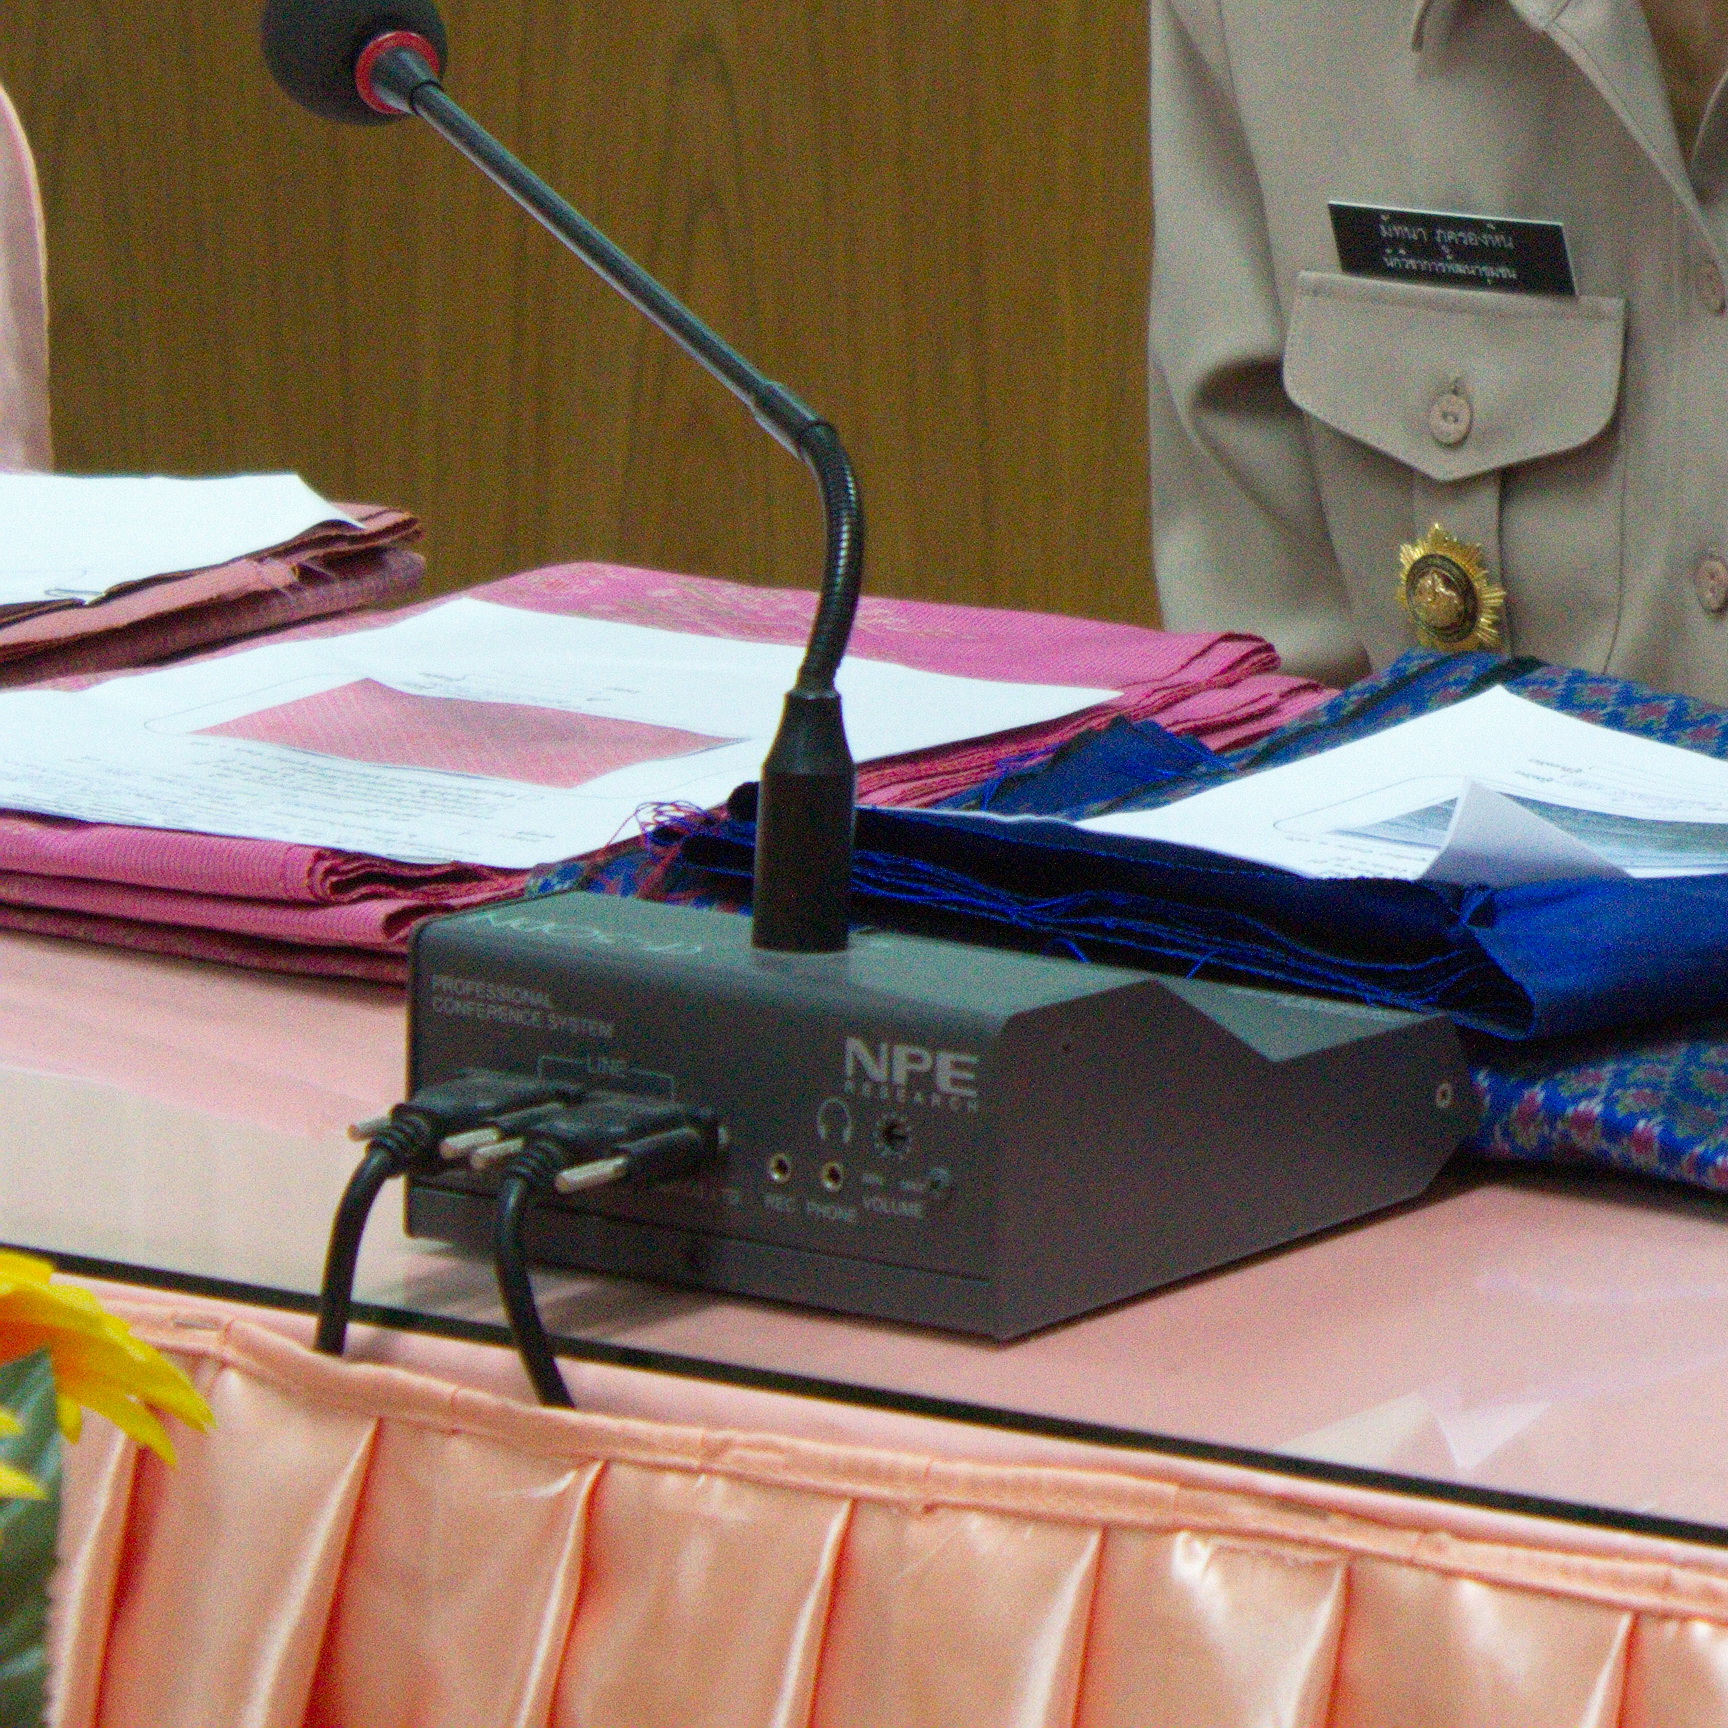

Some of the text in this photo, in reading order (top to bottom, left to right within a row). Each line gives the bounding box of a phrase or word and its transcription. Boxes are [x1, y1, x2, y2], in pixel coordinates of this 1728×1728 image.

[431, 973, 553, 1007] PROFESSIONAL
[431, 996, 615, 1039] CONFERENCE SYSTEM
[844, 1035, 981, 1098] NPE
[862, 1196, 924, 1220] VOLUME
